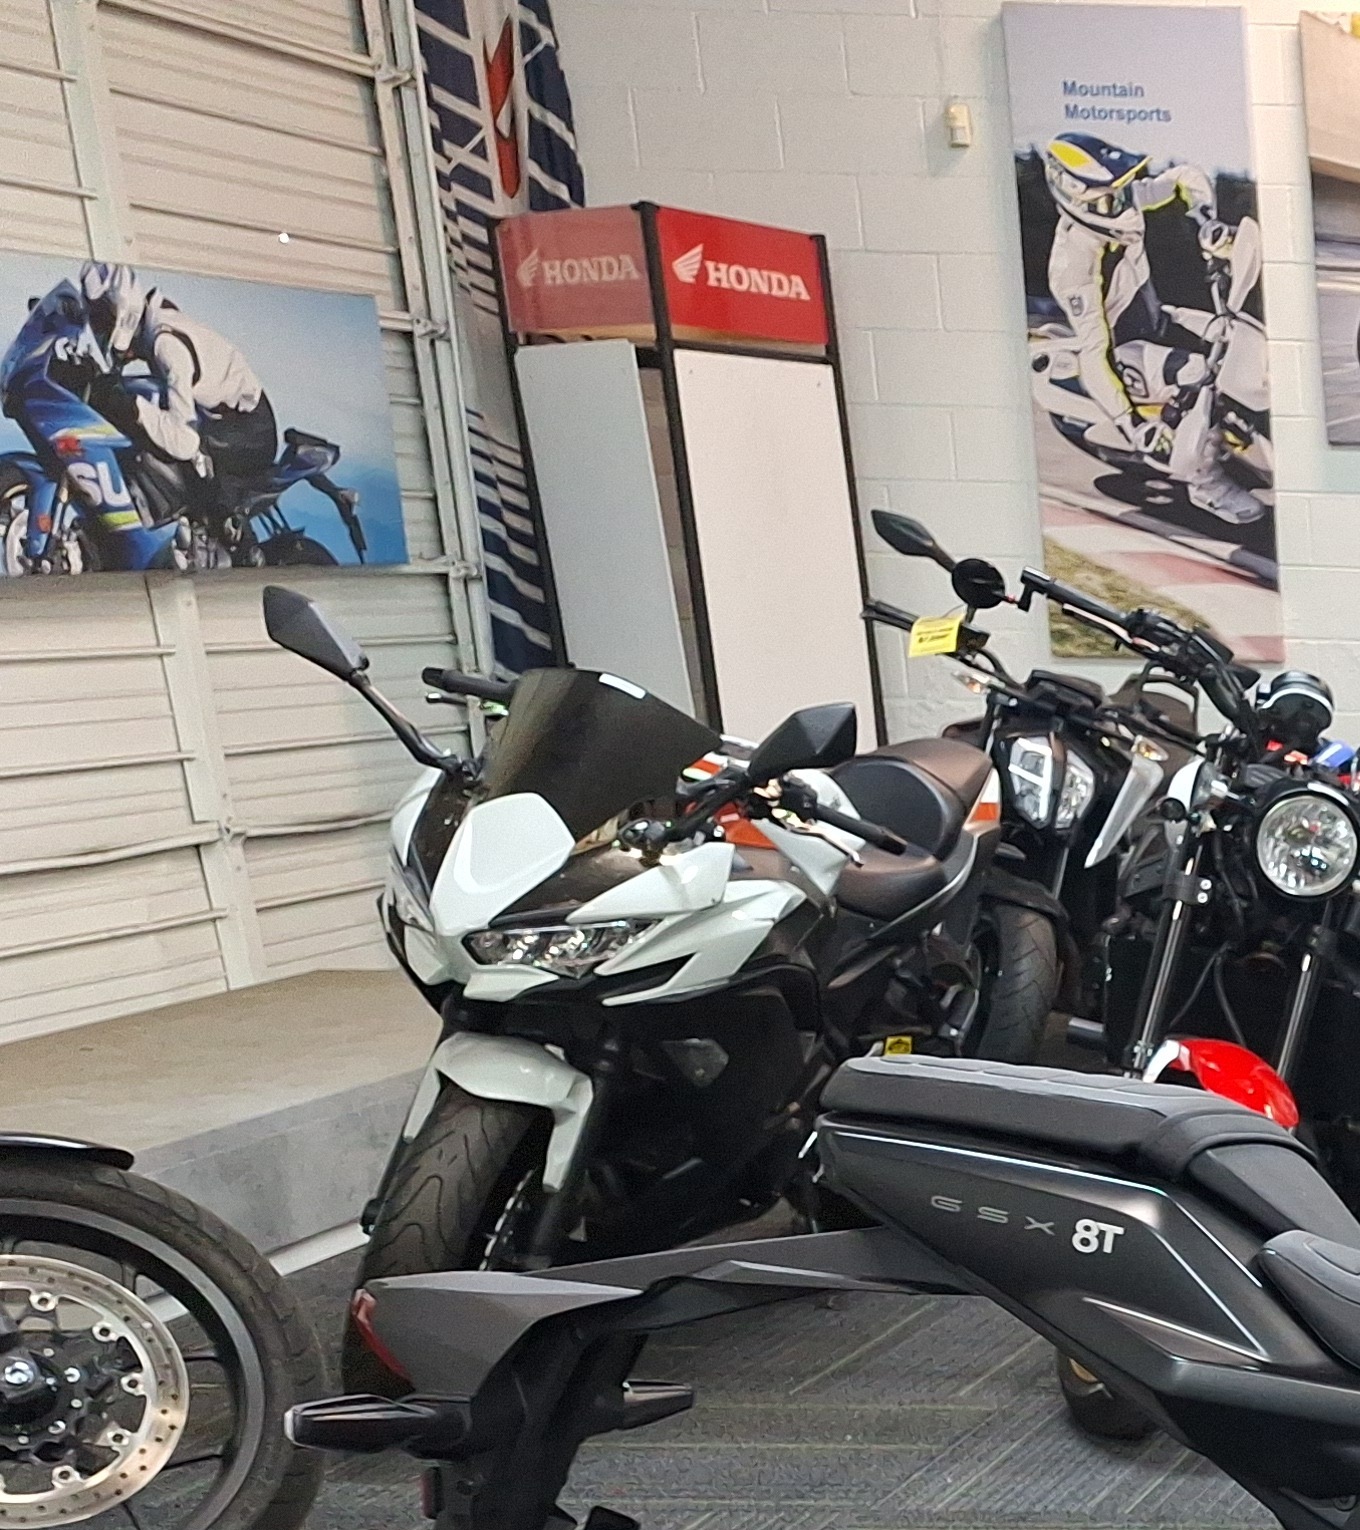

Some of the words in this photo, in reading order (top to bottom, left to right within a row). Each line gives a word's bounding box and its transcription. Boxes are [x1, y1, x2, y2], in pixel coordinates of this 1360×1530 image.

[1062, 80, 1144, 97] Mountain
[1064, 103, 1171, 123] Motorsports
[541, 254, 642, 286] HONDA
[704, 260, 811, 301] HONDA
[1071, 1218, 1125, 1254] 8T
